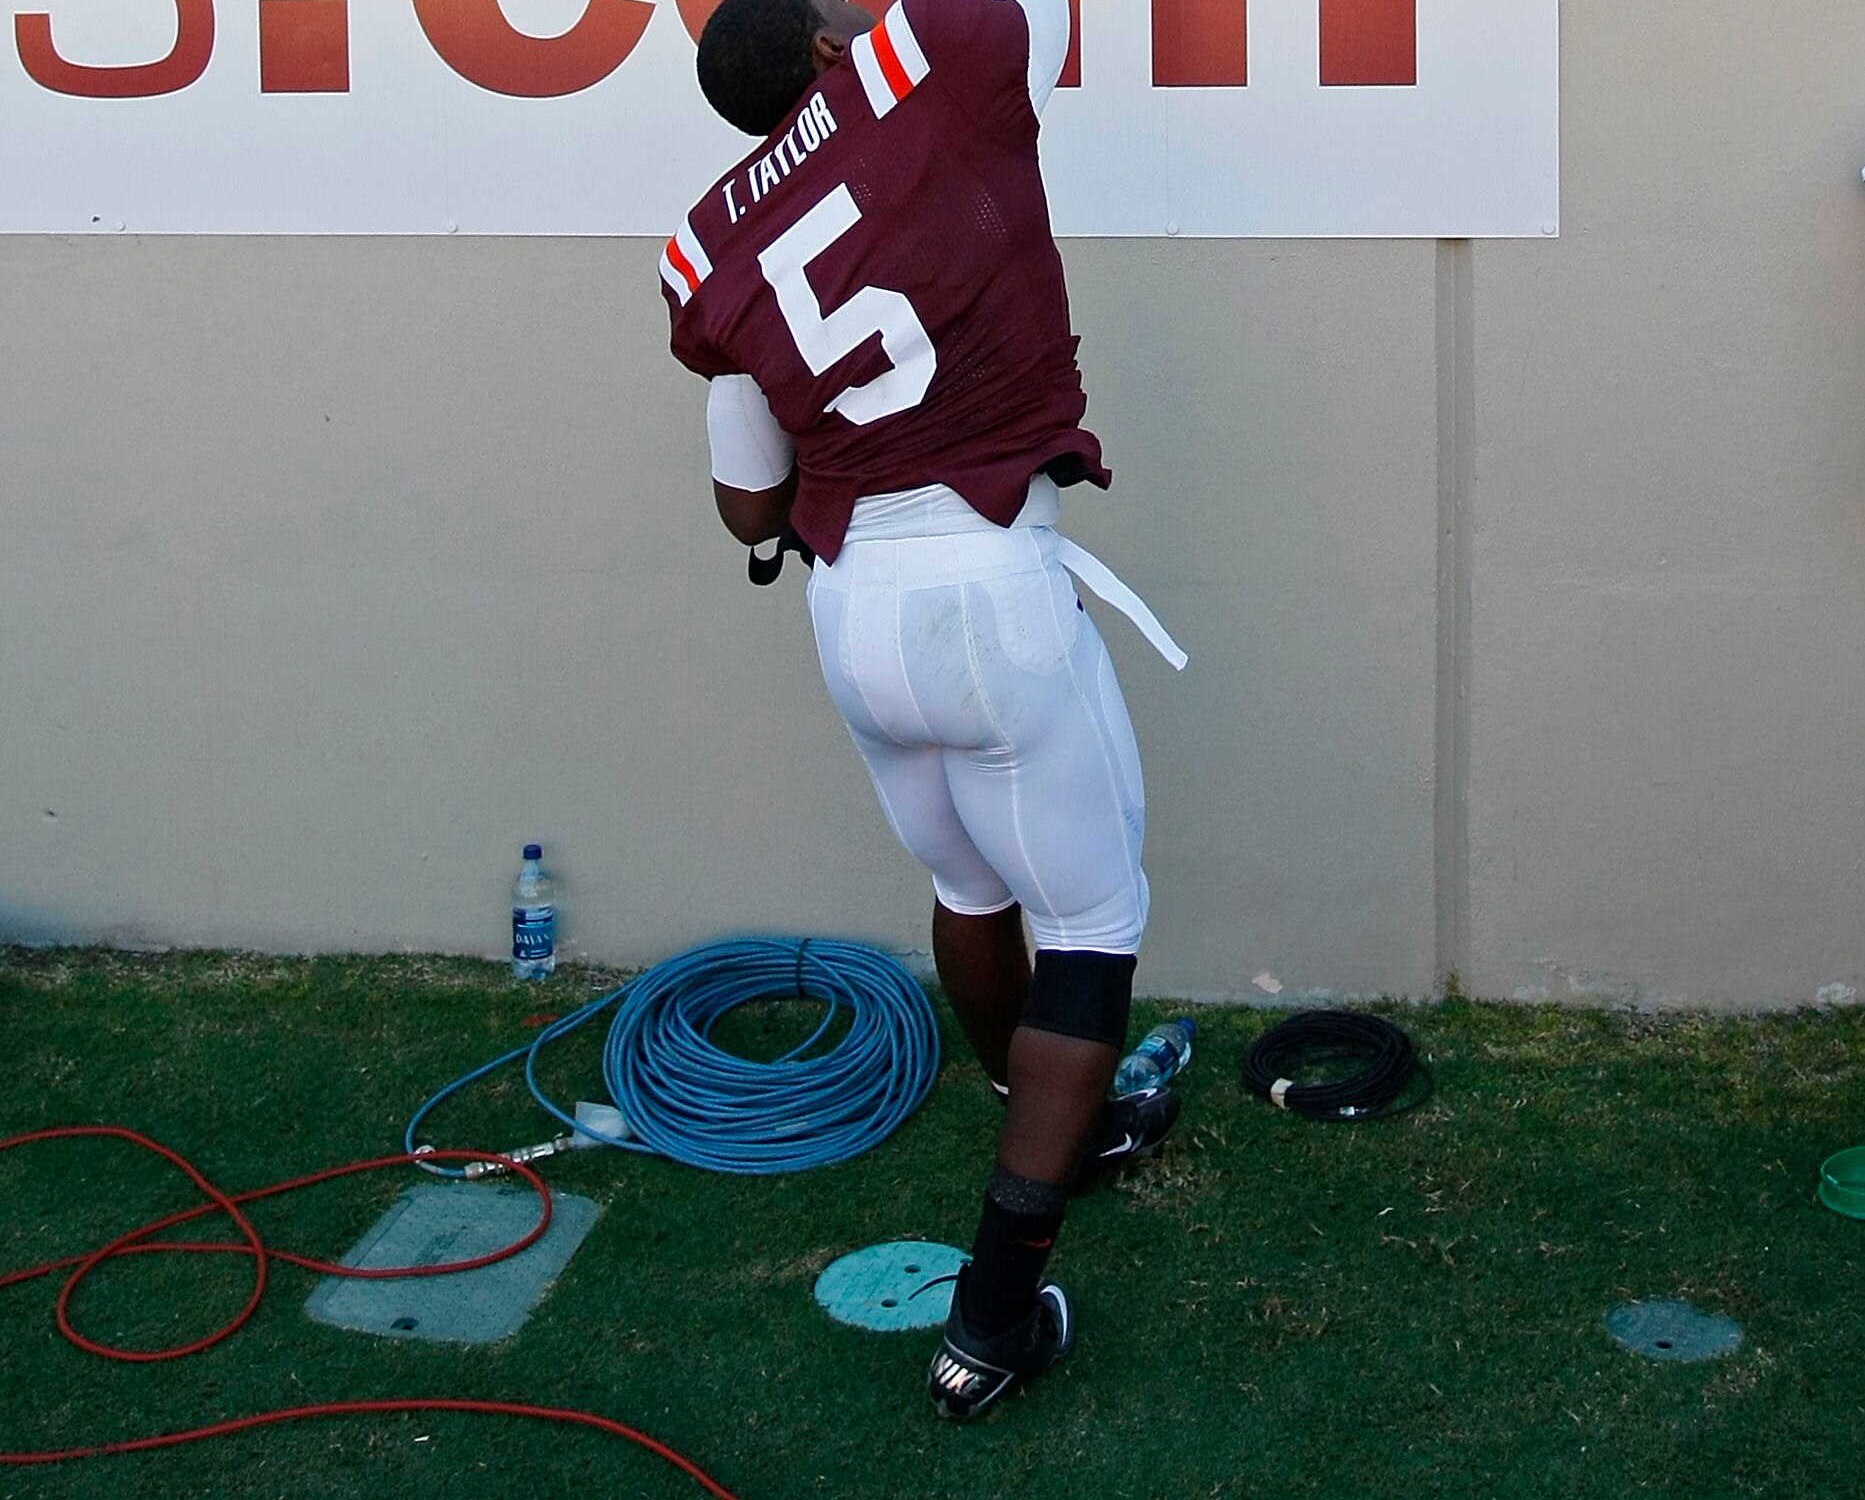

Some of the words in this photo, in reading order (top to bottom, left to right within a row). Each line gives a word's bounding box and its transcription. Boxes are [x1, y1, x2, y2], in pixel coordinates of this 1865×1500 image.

[722, 178, 746, 224] T.
[748, 91, 838, 204] TAYLOR
[756, 181, 938, 426] 5
